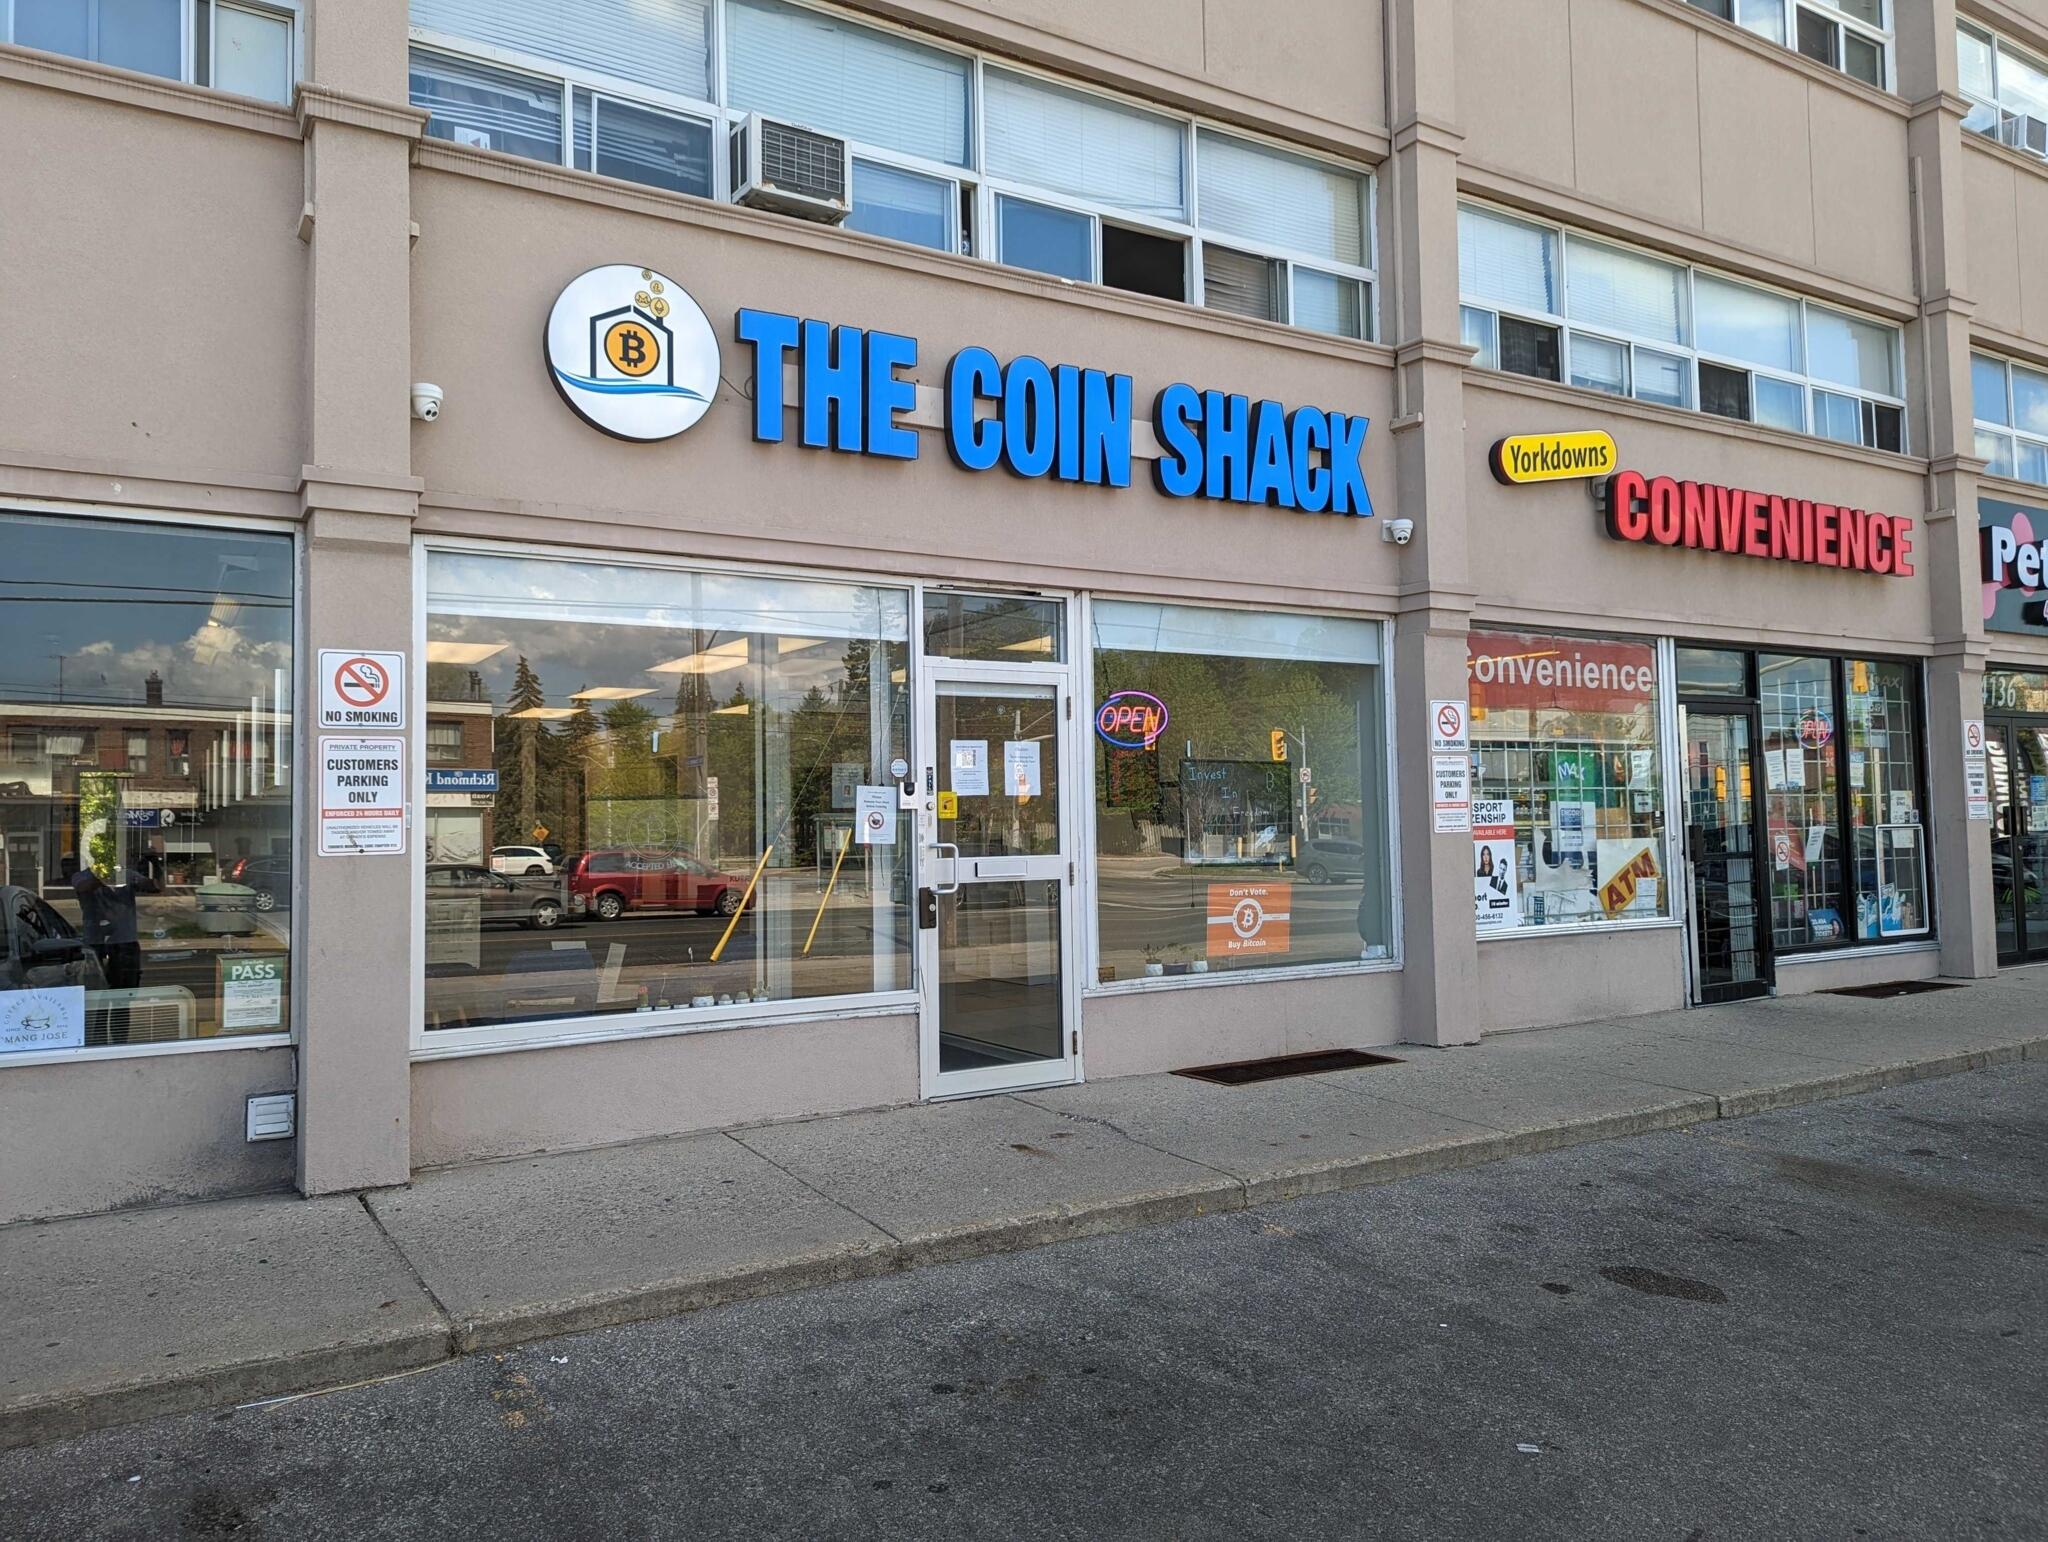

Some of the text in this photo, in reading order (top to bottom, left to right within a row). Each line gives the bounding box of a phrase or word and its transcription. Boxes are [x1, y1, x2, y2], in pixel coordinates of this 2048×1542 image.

[734, 307, 1375, 518] THE COIN SHACK
[1510, 442, 1608, 474] Yorkdowns
[1605, 469, 1915, 578] CONVENIENCE
[1466, 645, 1653, 692] onvenience
[325, 711, 398, 723] NO SMOKING
[1101, 706, 1161, 732] OPEN
[327, 759, 399, 771] CUSTOMERS
[1188, 766, 1227, 781] Invest
[1436, 770, 1466, 778] CUSTOMERS
[337, 775, 389, 787] PARKING
[348, 791, 378, 803] ONLY
[1444, 791, 1458, 799] ONLY
[1607, 852, 1656, 914] ATM
[1229, 888, 1269, 896] Don't Vote.
[1228, 939, 1266, 949] Buy Bitcoin
[231, 964, 276, 980] PASS
